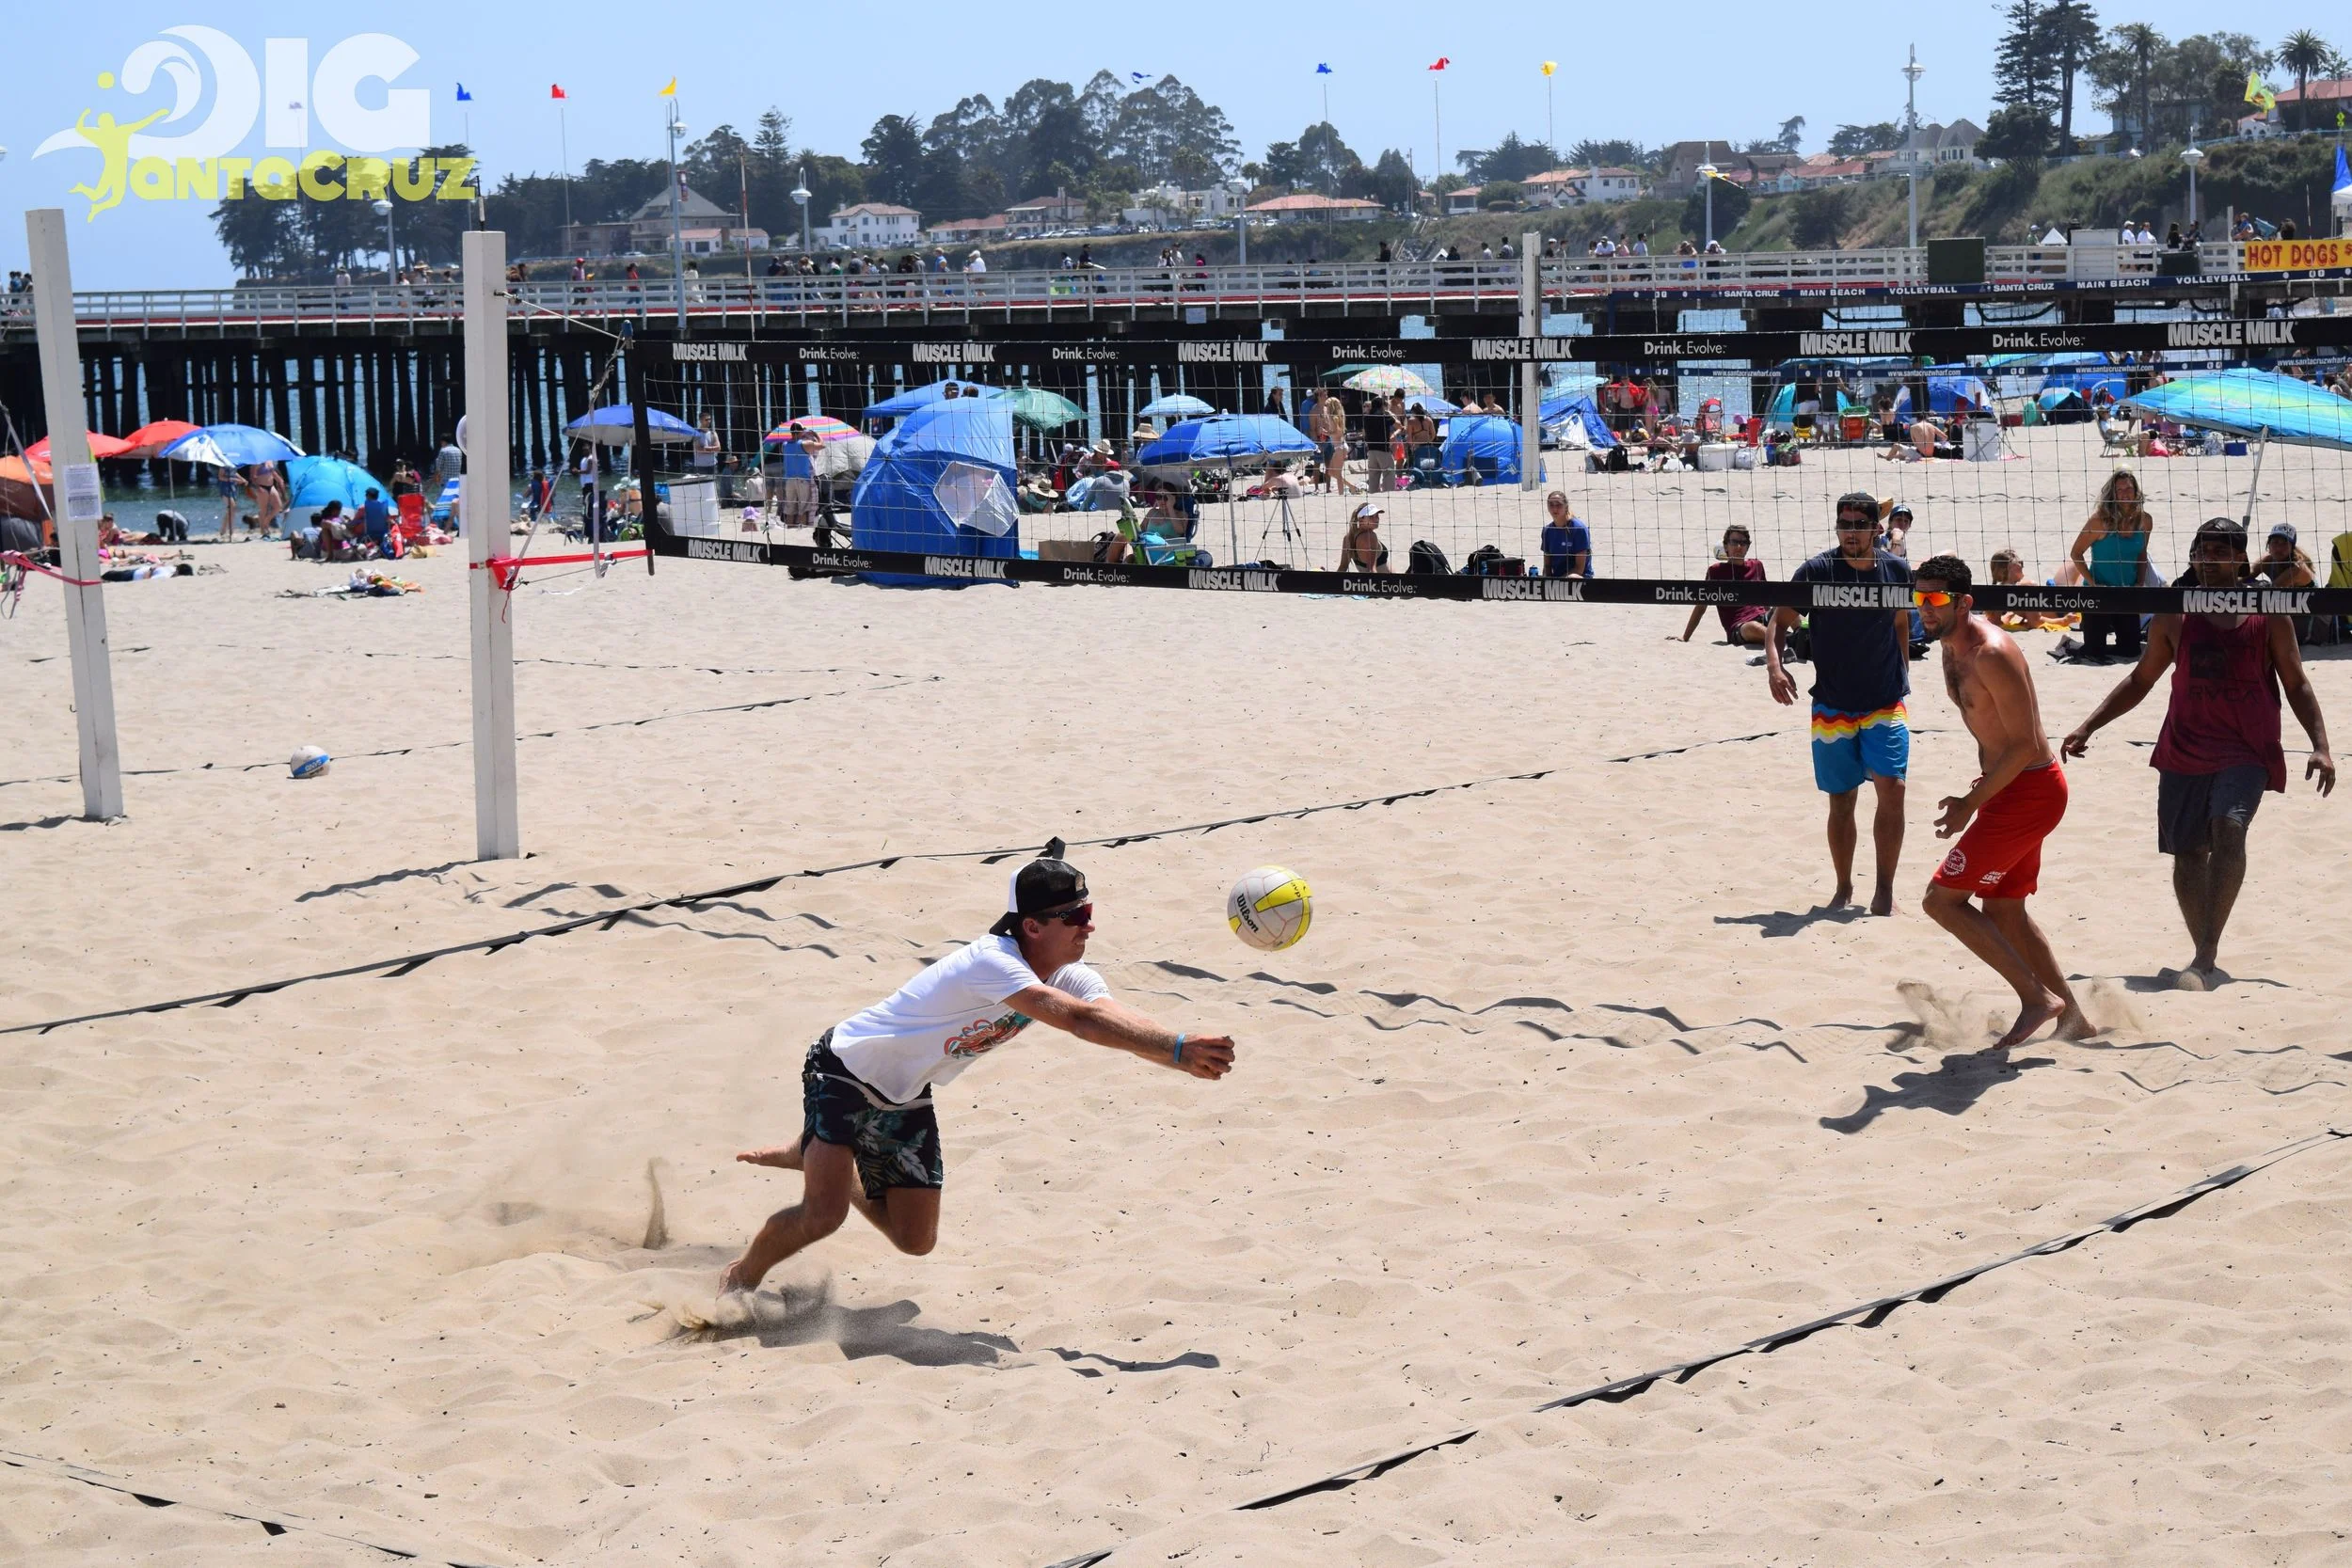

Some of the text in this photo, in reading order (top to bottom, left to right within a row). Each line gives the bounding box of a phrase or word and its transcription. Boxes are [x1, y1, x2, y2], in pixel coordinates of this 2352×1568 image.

[2248, 245, 2282, 267] HOT
[2291, 243, 2339, 266] DOGS
[2076, 278, 2151, 290] MAIN BEACH
[2175, 273, 2251, 285] VOLLEYBALL
[1724, 289, 1780, 298] SANTA CRUZ
[1800, 288, 1866, 297] MAIN BEACH
[1889, 286, 1958, 295] VOLLEYBALL
[1993, 282, 2056, 293] SANTA CRUZ
[1993, 333, 2038, 347] Drink.
[2168, 322, 2242, 346] MUSCLE
[1471, 338, 1531, 359] MUSCLE
[1645, 341, 1684, 354] Drink.
[1800, 331, 1866, 355] MUSCLE
[673, 341, 717, 360] MUSCLE
[800, 347, 829, 358] Drink.
[914, 344, 961, 362] MUSCLE
[1053, 347, 1085, 359] Drink.
[1178, 341, 1231, 361] MUSCLE
[1333, 345, 1369, 357] Drink.
[1712, 369, 1782, 378] www.santacruzwharf.com
[1887, 368, 1962, 377] www.santacruzwharf.com
[2075, 364, 2154, 373] www.santacruzwharf.com
[688, 538, 733, 561] MUSCLE
[813, 553, 842, 565] Drink.
[925, 557, 972, 577] MUSCLE
[1064, 568, 1096, 580] Drink.
[1188, 570, 1242, 592] MUSCLE
[1343, 579, 1379, 592] Drink.
[1482, 579, 1542, 601] MUSCLE
[1656, 587, 1696, 600] Drink.
[1813, 585, 1879, 607] MUSCLE
[2008, 594, 2052, 607] Drink.
[2184, 591, 2258, 613] MUSCLE
[1236, 893, 1260, 934] Wilson
